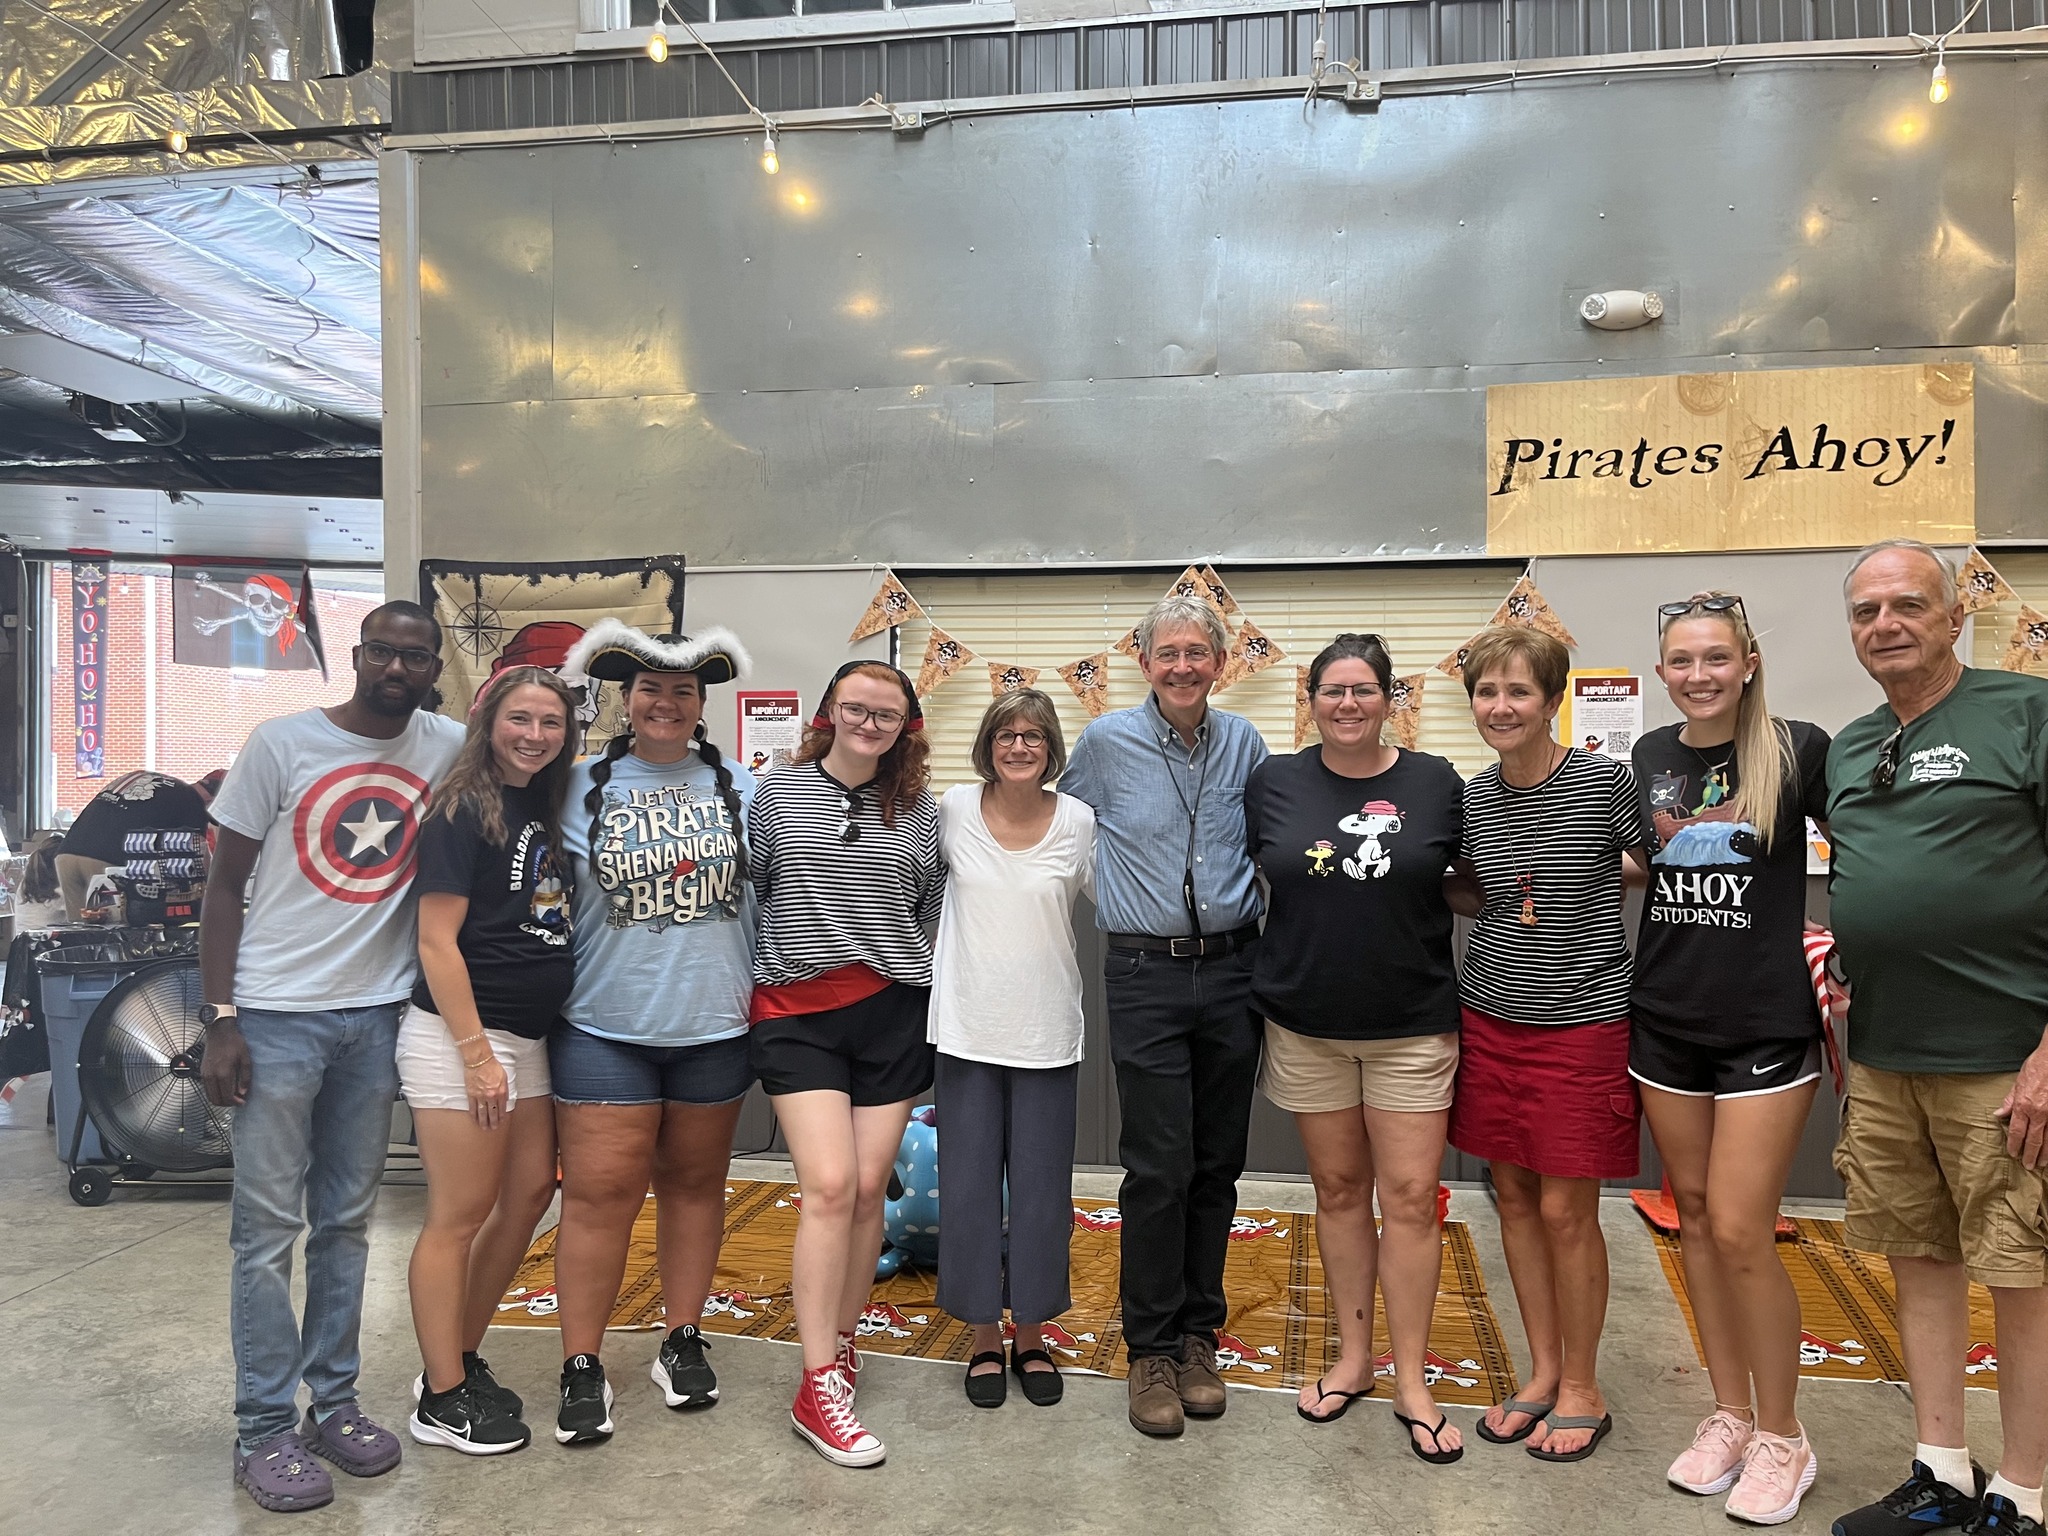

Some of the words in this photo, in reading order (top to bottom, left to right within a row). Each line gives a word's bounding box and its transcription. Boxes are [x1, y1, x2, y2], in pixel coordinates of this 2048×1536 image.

[1490, 436, 1723, 496] Pirates
[1743, 418, 1956, 487] Ahoy!
[78, 585, 99, 634] YO
[80, 642, 98, 691] HO
[1582, 686, 1631, 695] IMPORTANT
[80, 703, 98, 752] HO
[751, 706, 792, 715] IMPORTANT
[510, 824, 534, 891] BUILDING
[1654, 872, 1753, 907] AHOY
[1651, 906, 1752, 929] STUDENTS!
